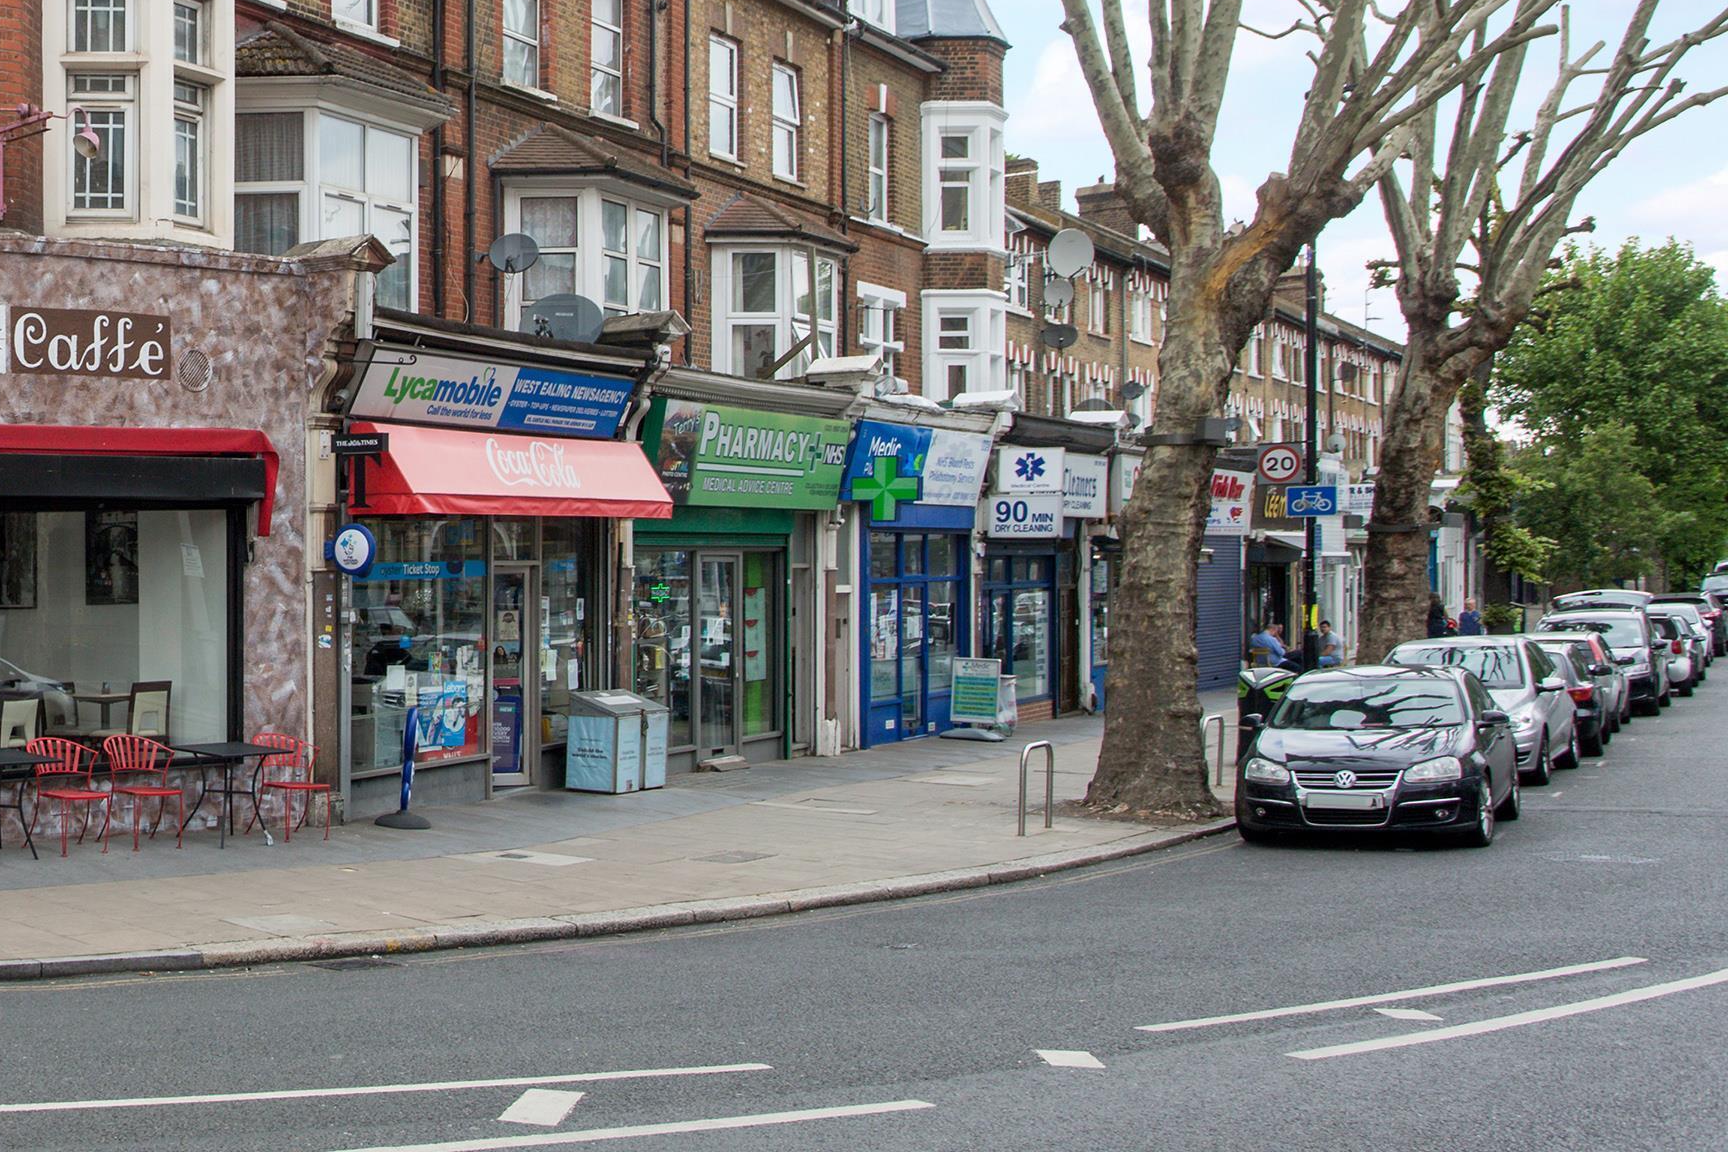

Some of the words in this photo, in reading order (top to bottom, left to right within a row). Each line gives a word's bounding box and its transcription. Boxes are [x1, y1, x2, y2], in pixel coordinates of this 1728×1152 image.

[384, 366, 503, 408] Lycamobile
[514, 378, 543, 395] WEST
[539, 382, 573, 399] EALING
[571, 385, 627, 405] NEWSAGENCY
[427, 404, 441, 415] Call
[441, 406, 450, 417] the
[452, 407, 470, 419] world
[470, 409, 480, 420] for
[479, 410, 493, 421] less
[698, 409, 810, 464] PHARMACY
[823, 444, 845, 465] NHS
[1266, 456, 1295, 472] 20
[703, 476, 736, 493] MEDICAL
[738, 480, 765, 494] ADVICE
[766, 481, 794, 496] CENTRE
[995, 500, 1029, 523] 90
[1031, 513, 1054, 523] MIN
[994, 524, 1012, 533] DRY
[1012, 524, 1053, 533] CLEANING
[403, 562, 424, 575] Ticket
[424, 564, 440, 577] Stop
